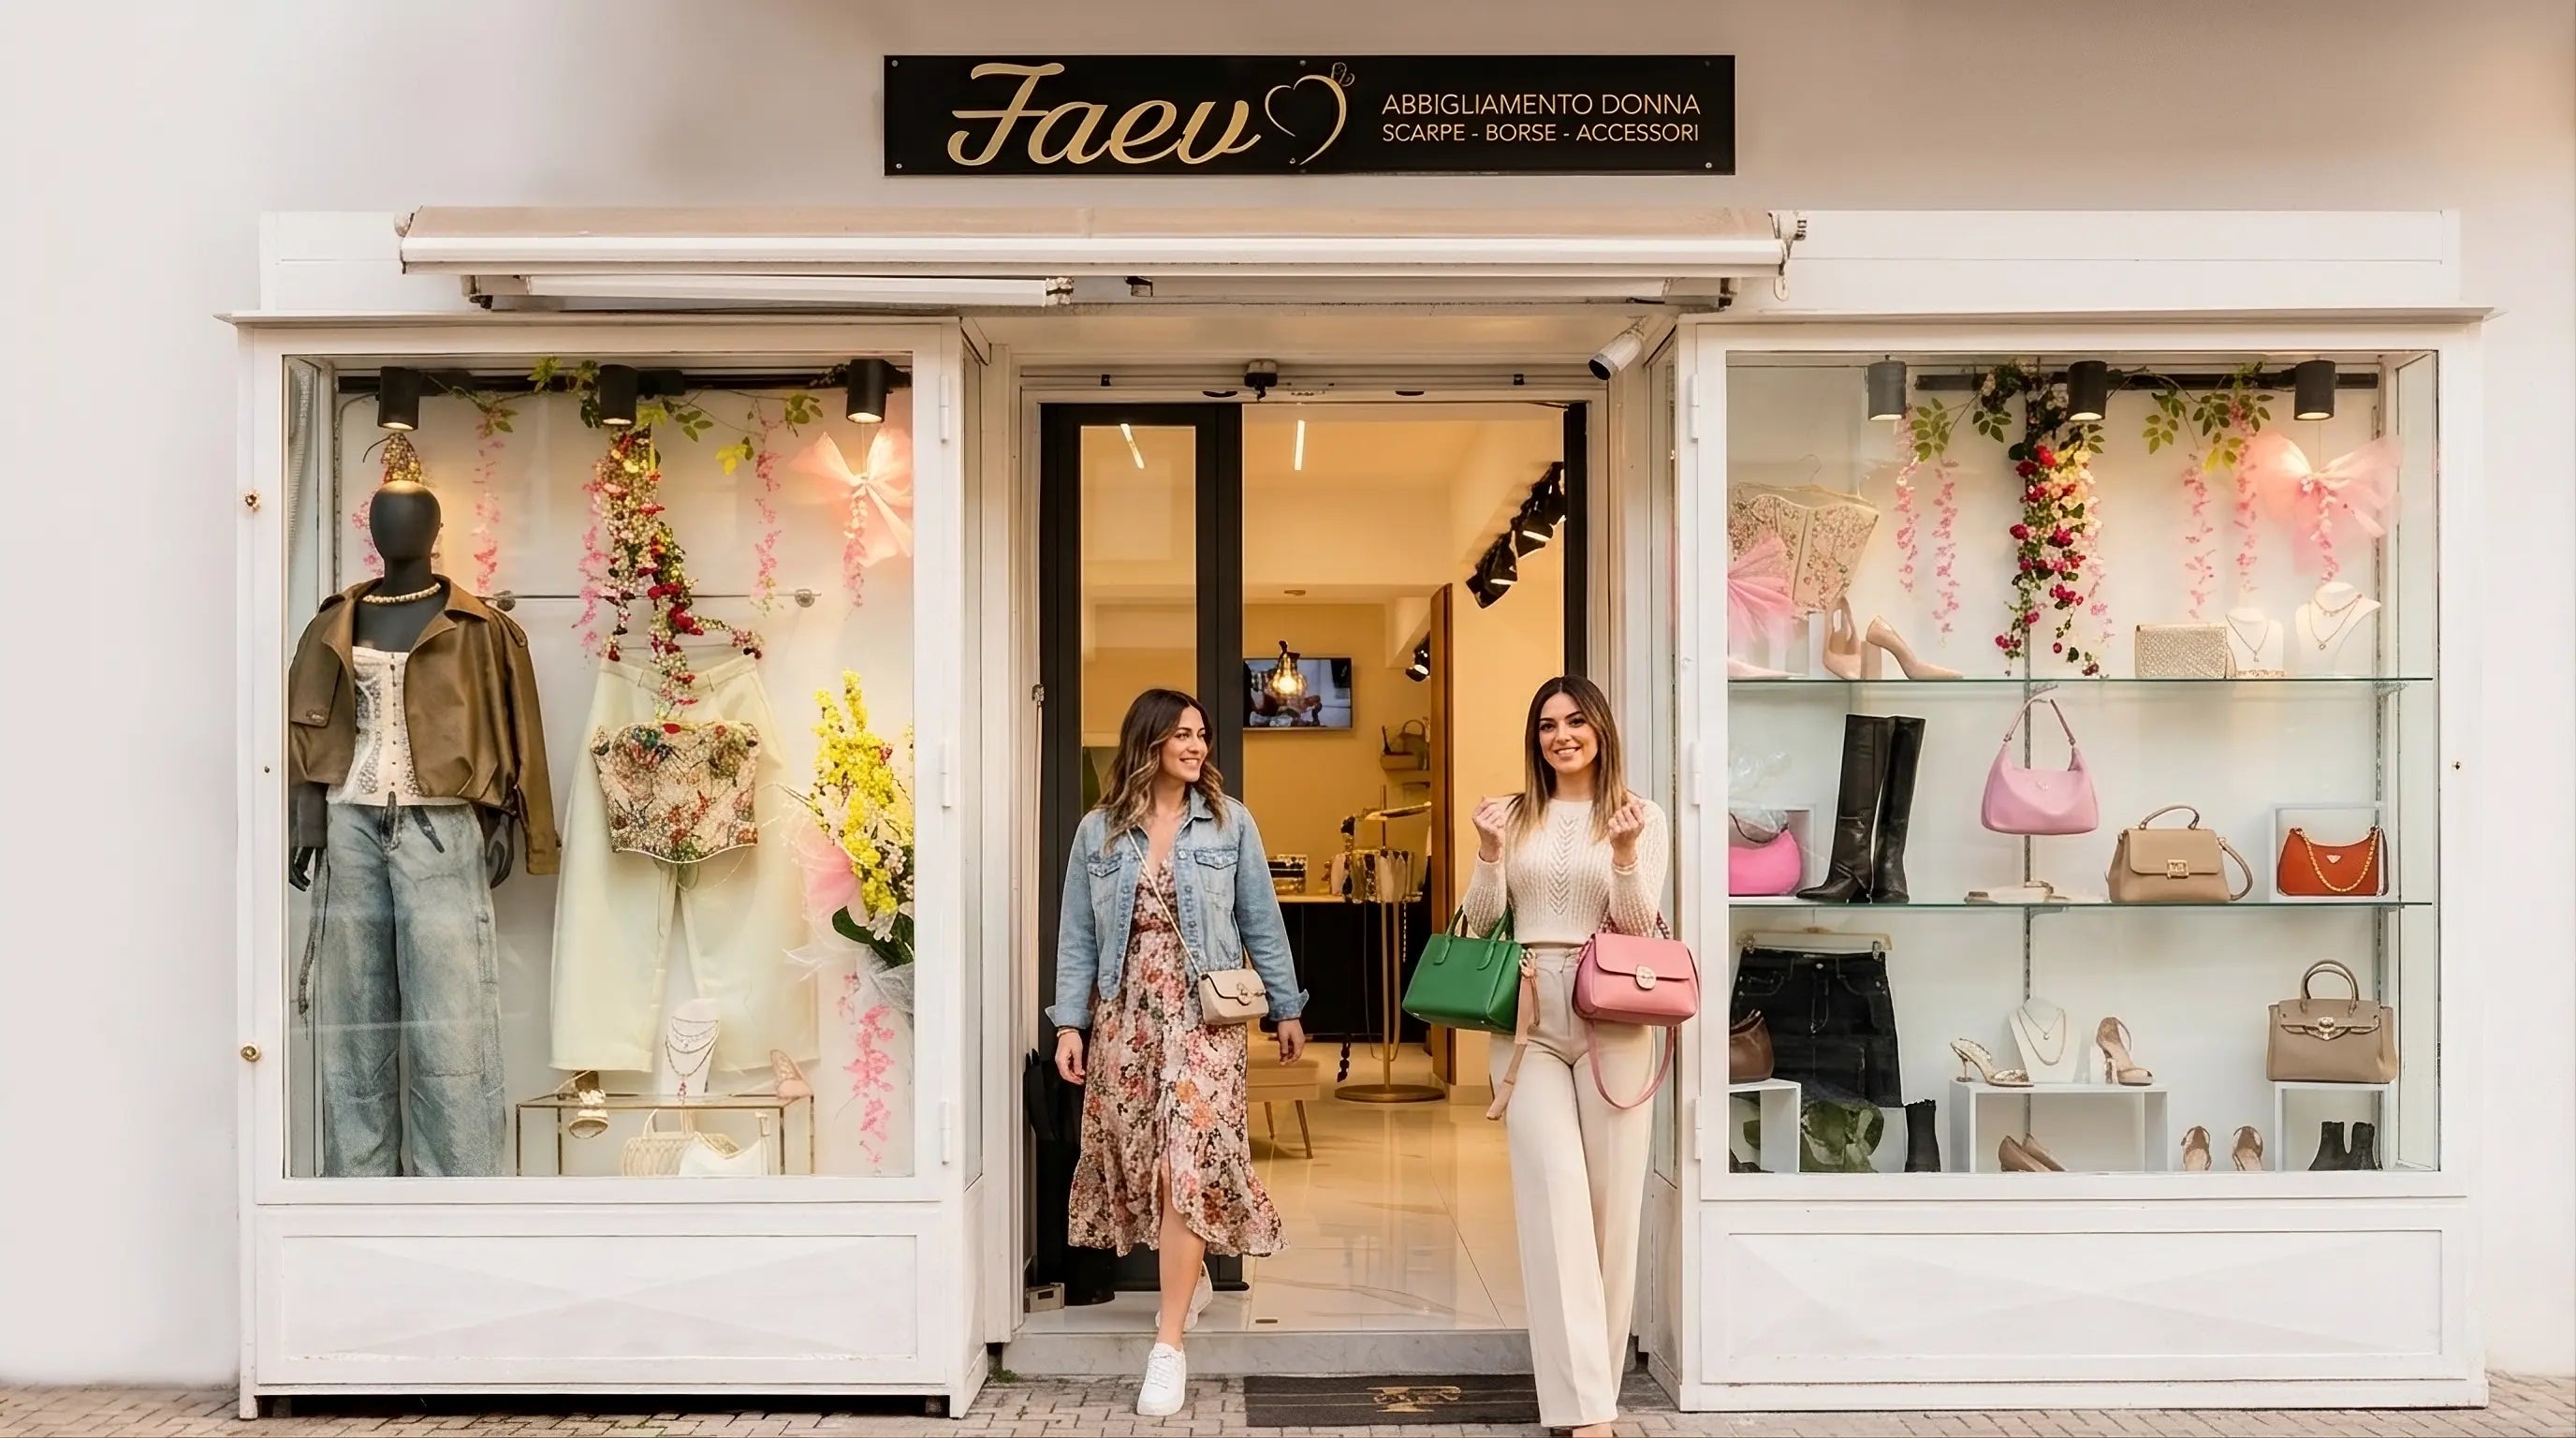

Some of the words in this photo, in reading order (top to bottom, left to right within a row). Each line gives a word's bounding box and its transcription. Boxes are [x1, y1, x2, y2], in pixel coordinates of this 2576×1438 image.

[1382, 93, 1593, 115] ABBIGLIAMENTO
[1602, 93, 1701, 115] DONNA
[1383, 123, 1466, 142] SCARPE
[1486, 123, 1557, 142] BORSE
[1575, 123, 1699, 142] ACCESSORI
